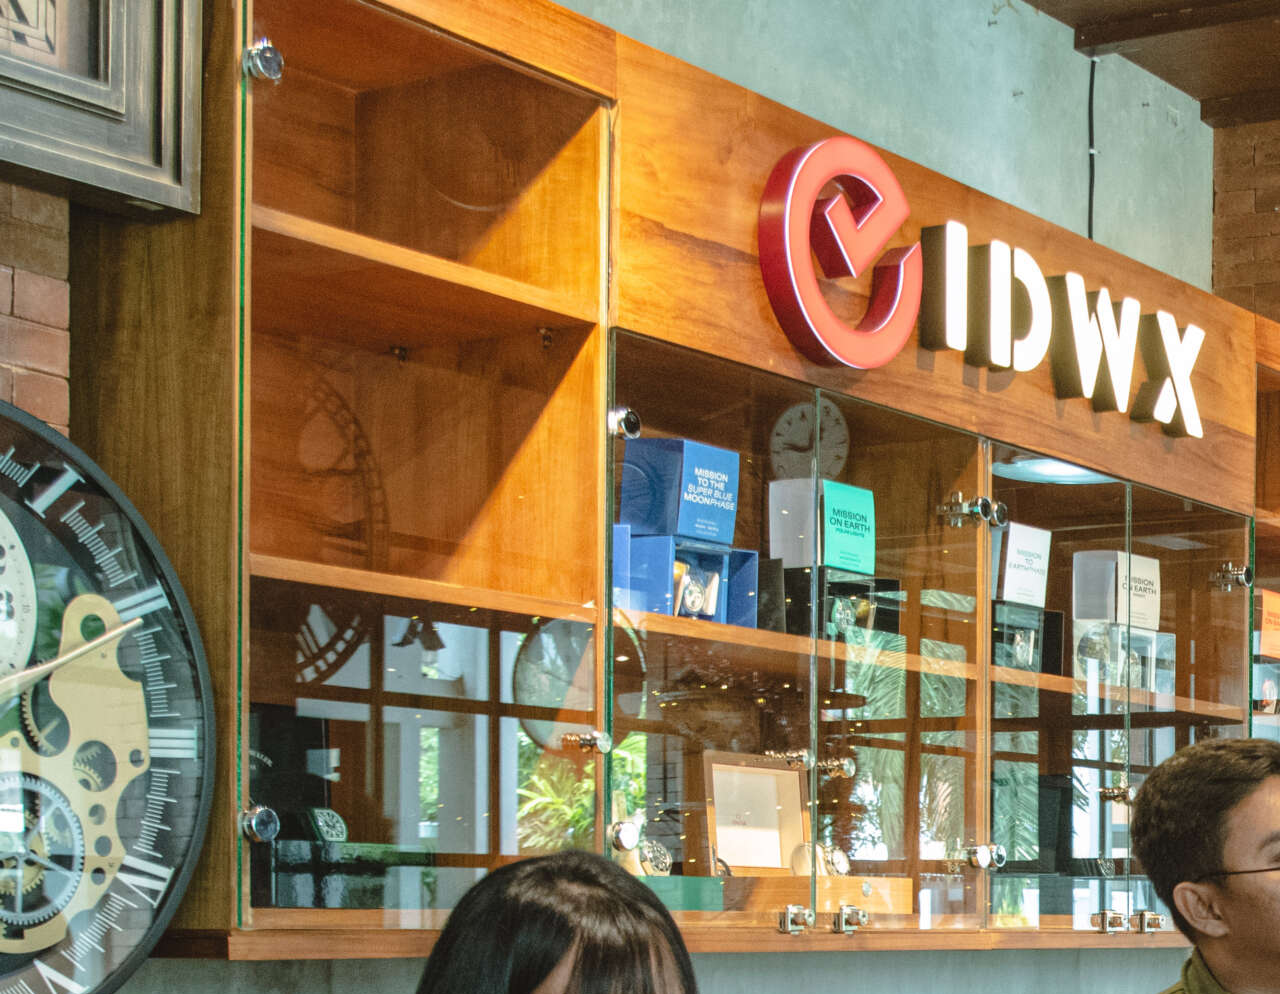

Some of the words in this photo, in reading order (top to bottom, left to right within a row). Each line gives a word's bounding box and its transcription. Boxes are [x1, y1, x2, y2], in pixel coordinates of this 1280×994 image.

[944, 220, 1206, 438] IDWX
[694, 467, 728, 482] MISSION
[698, 477, 709, 487] TO
[710, 480, 725, 490] THE
[688, 483, 713, 496] SUPER
[714, 489, 734, 501] BLUE
[684, 492, 735, 510] MOONPHASE
[832, 506, 868, 522] MISSION
[830, 517, 843, 527] ON
[844, 520, 871, 533] EARTH
